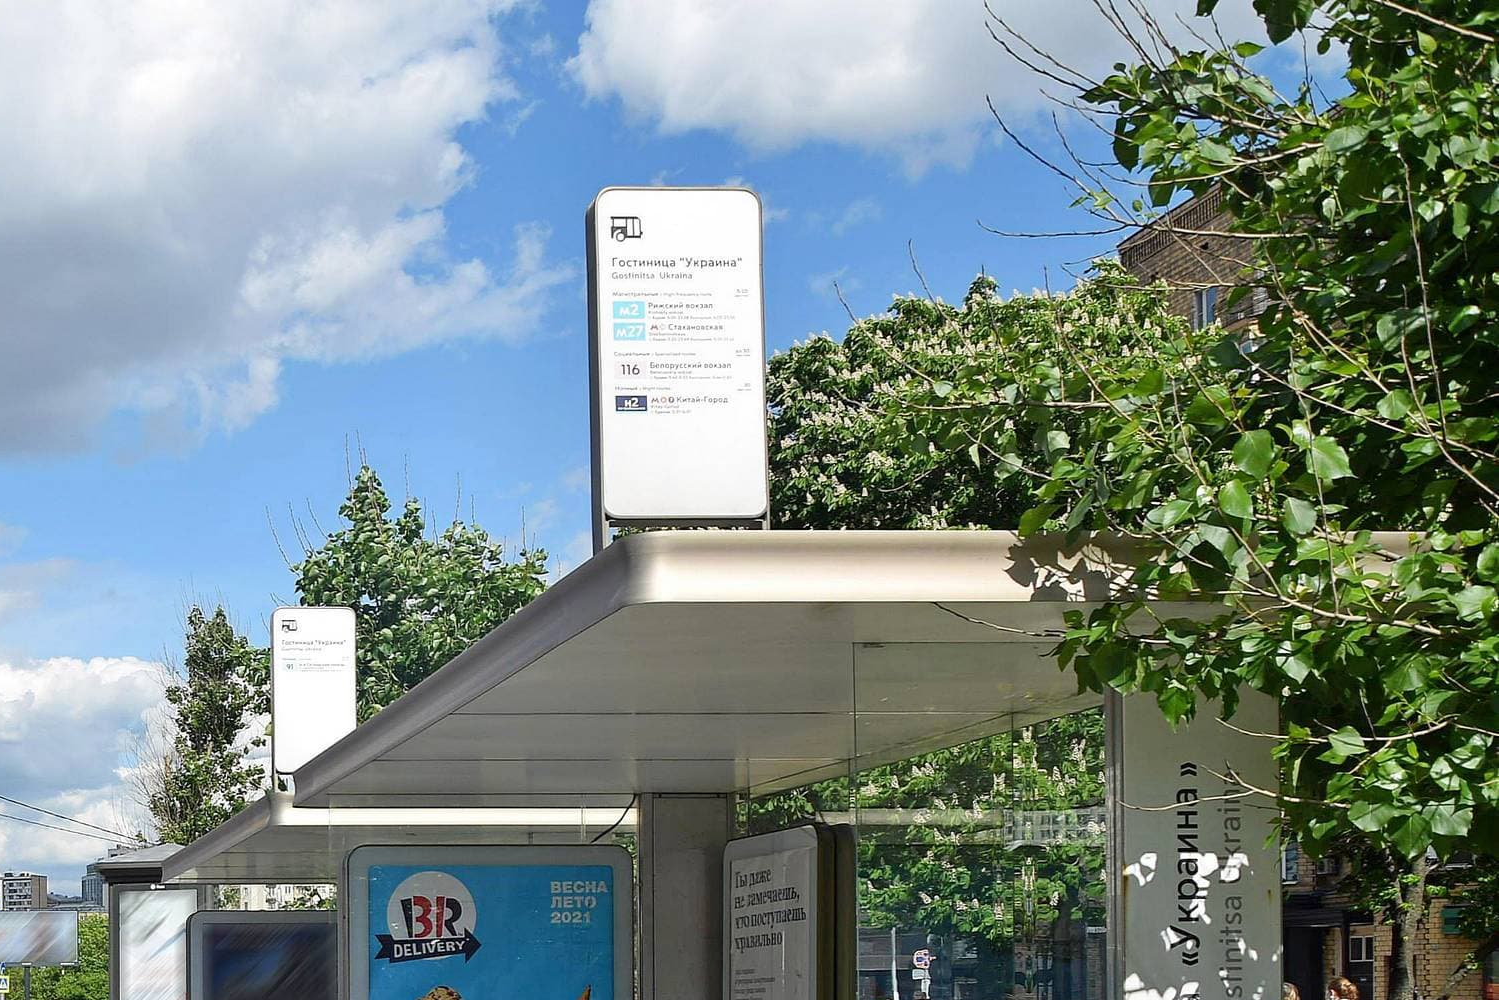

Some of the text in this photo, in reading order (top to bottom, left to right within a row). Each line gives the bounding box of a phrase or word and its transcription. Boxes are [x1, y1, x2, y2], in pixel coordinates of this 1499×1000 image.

[611, 257, 743, 270] Гостиница "Украина"
[611, 272, 693, 280] Gostinitsa Ukraina
[621, 364, 640, 376] 116
[649, 361, 702, 370] Белорусский
[549, 880, 609, 894] ВЕСНА
[549, 896, 597, 908] ЛЕТО
[400, 895, 463, 939] BR
[549, 912, 592, 925] 2021
[393, 939, 466, 959] DELIVERY
